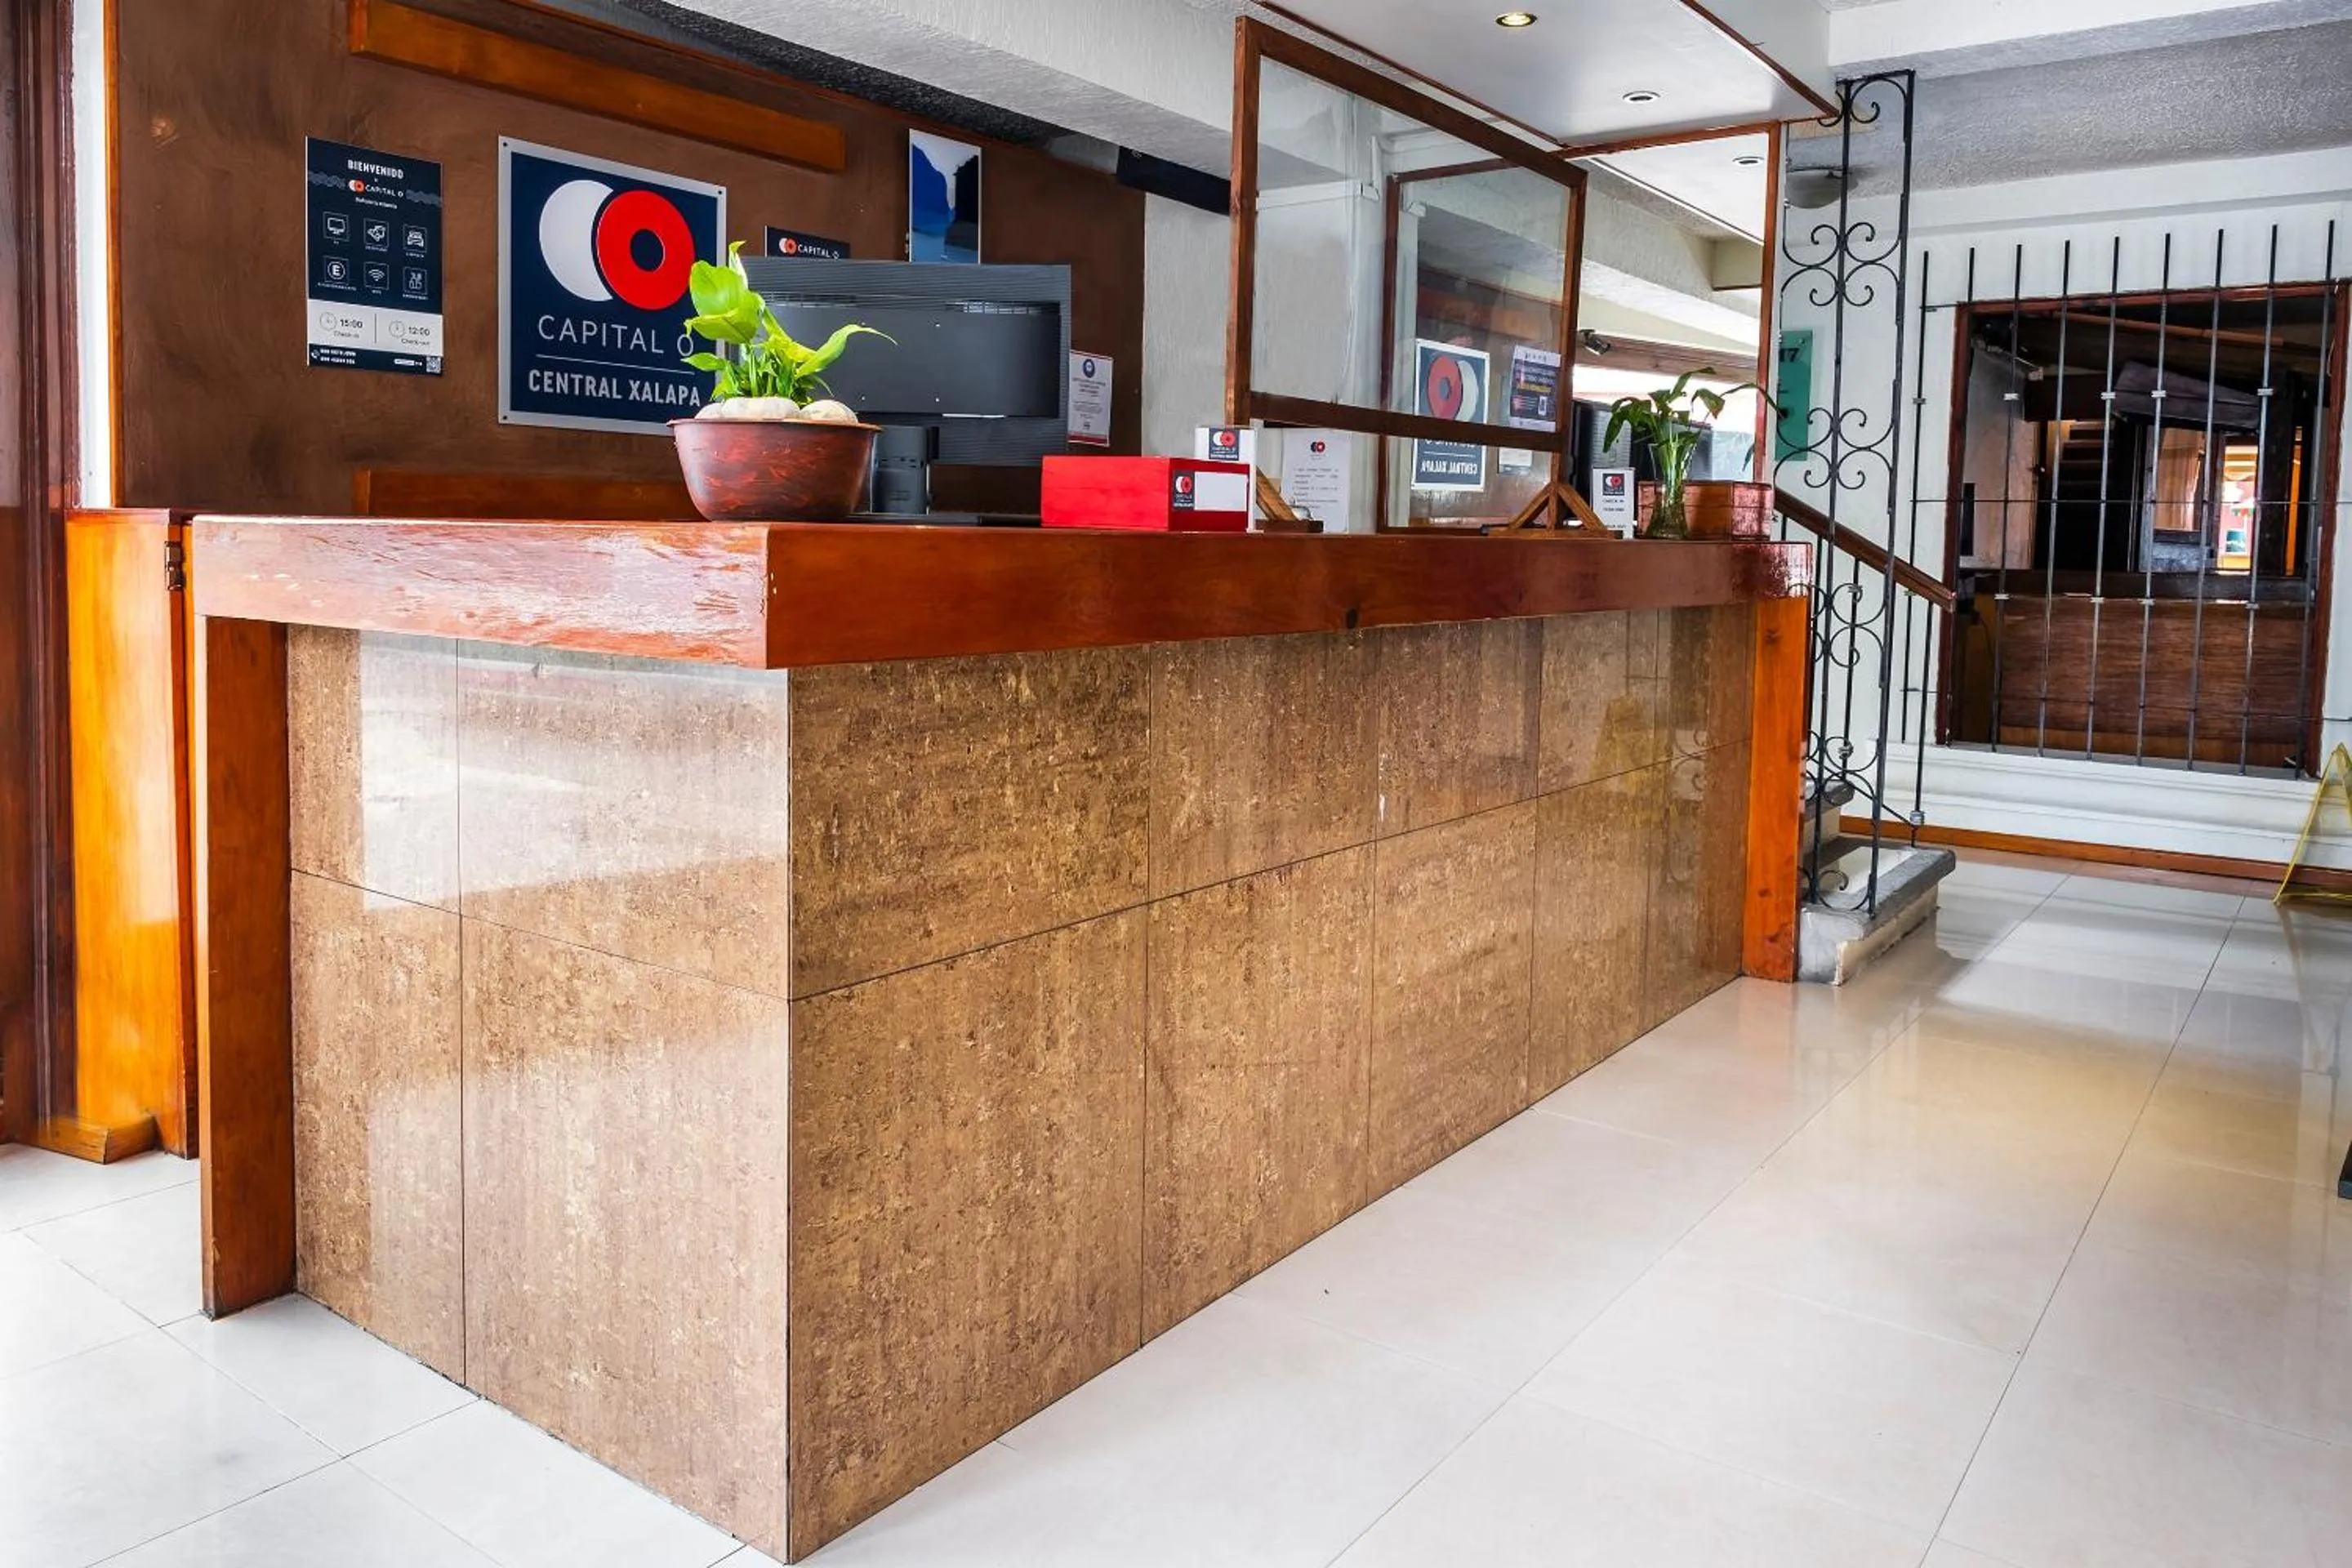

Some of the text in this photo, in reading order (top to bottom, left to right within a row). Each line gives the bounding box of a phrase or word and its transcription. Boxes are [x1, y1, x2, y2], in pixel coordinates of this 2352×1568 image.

[347, 159, 403, 179] BIENVENIDO
[365, 185, 395, 197] CAPITAL
[797, 244, 830, 258] CAPITAL
[340, 318, 363, 328] 15:00
[538, 314, 694, 357] CAPITAL O
[528, 369, 701, 407] CENTRAL XALAPA
